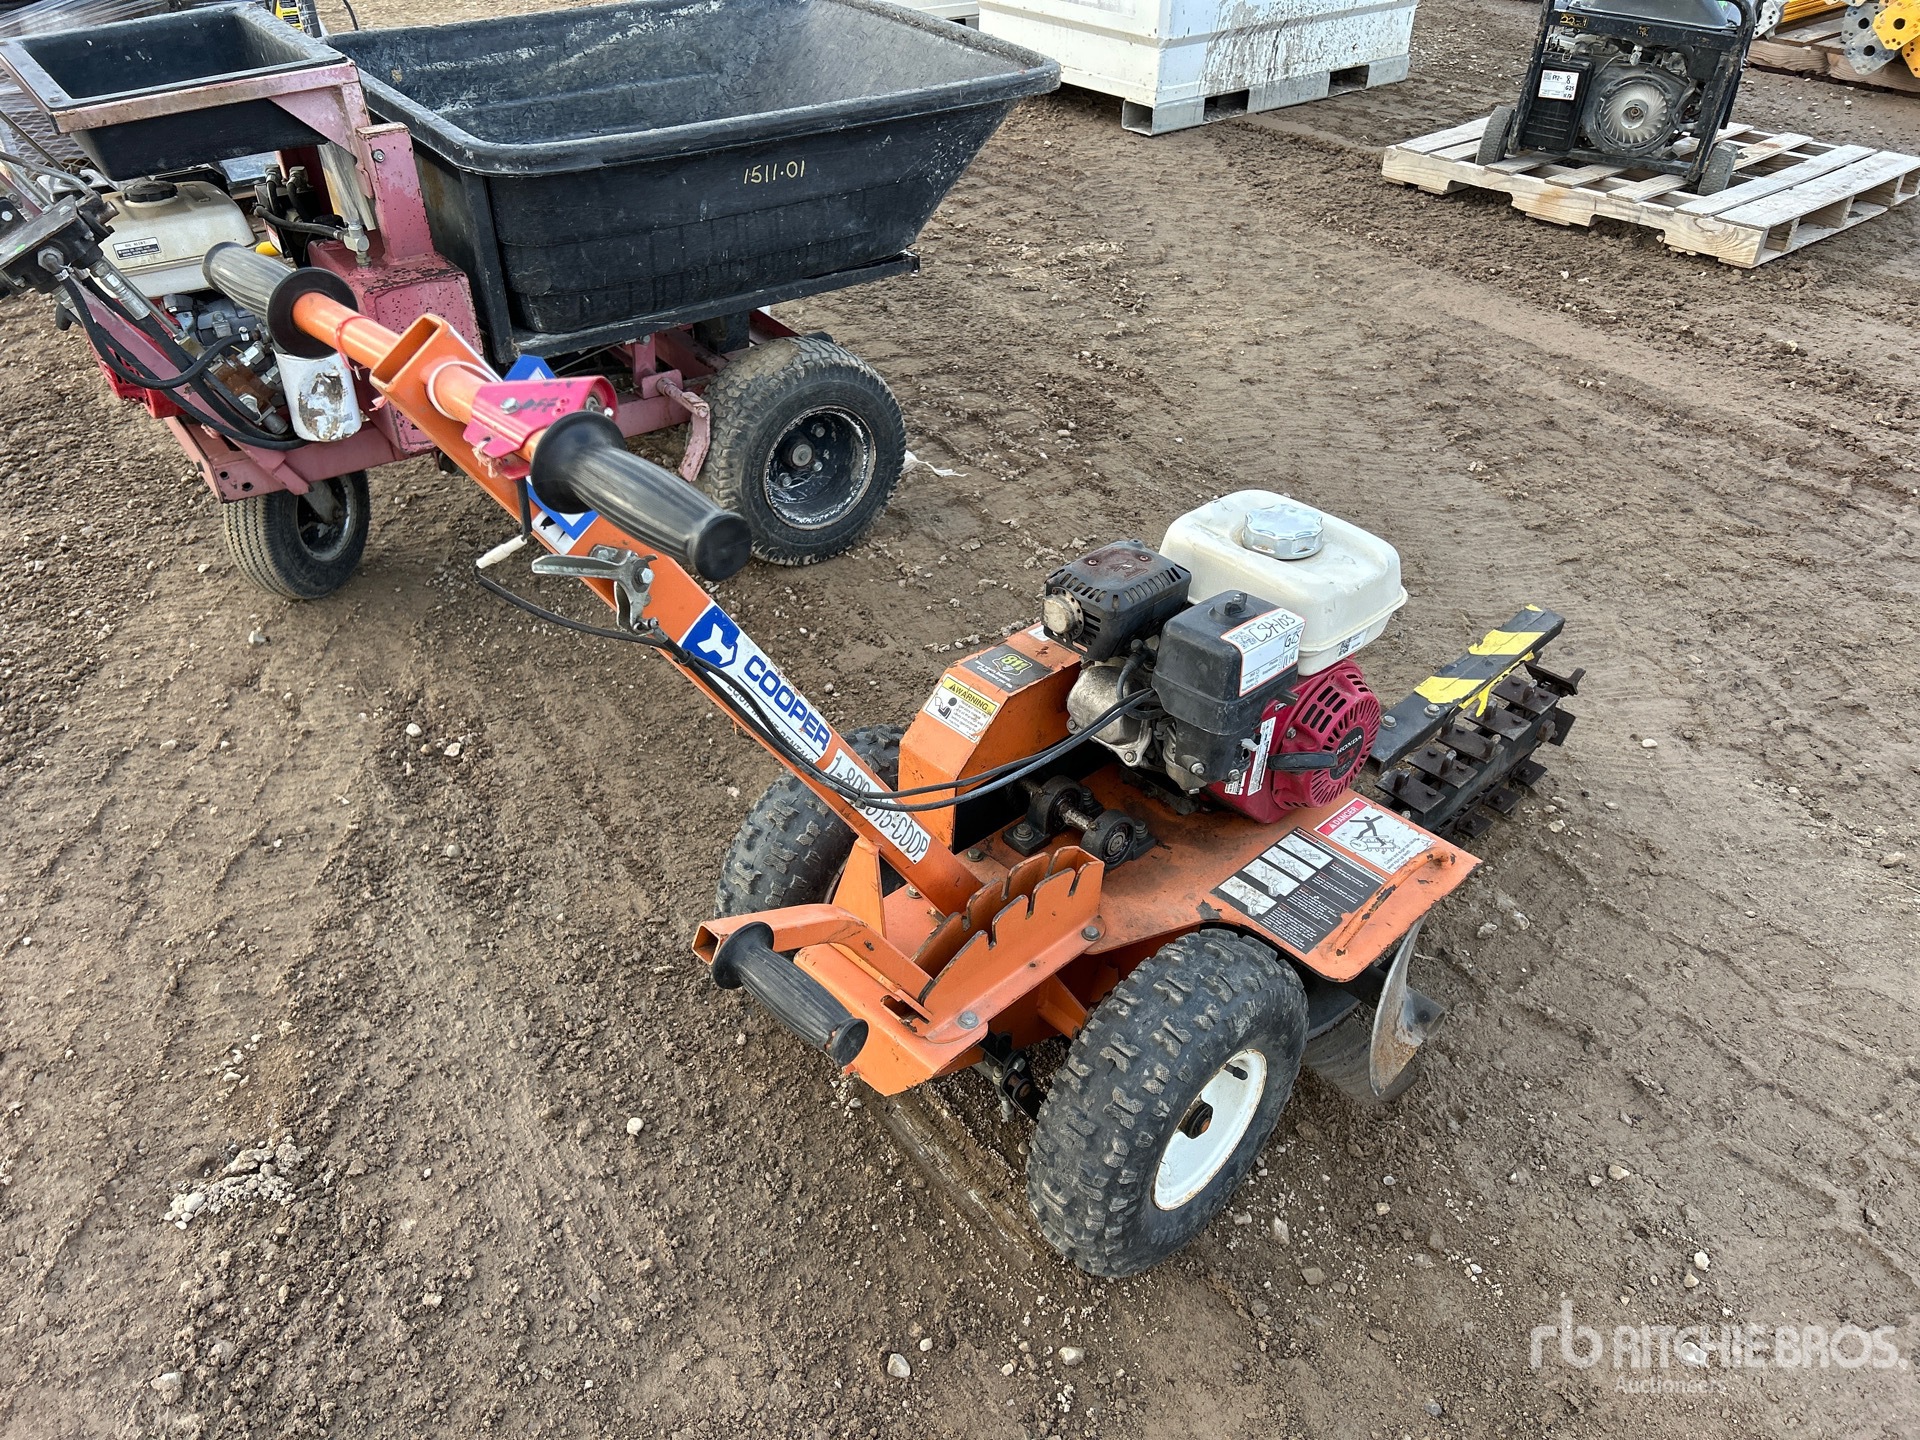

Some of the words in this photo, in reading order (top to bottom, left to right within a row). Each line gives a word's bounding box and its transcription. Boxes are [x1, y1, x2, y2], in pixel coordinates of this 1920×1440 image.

[1001, 655, 1028, 671] 811
[744, 654, 831, 751] COOPER
[954, 686, 989, 711] WARNING
[1336, 735, 1362, 755] HONDA
[1334, 807, 1359, 827] DANGER
